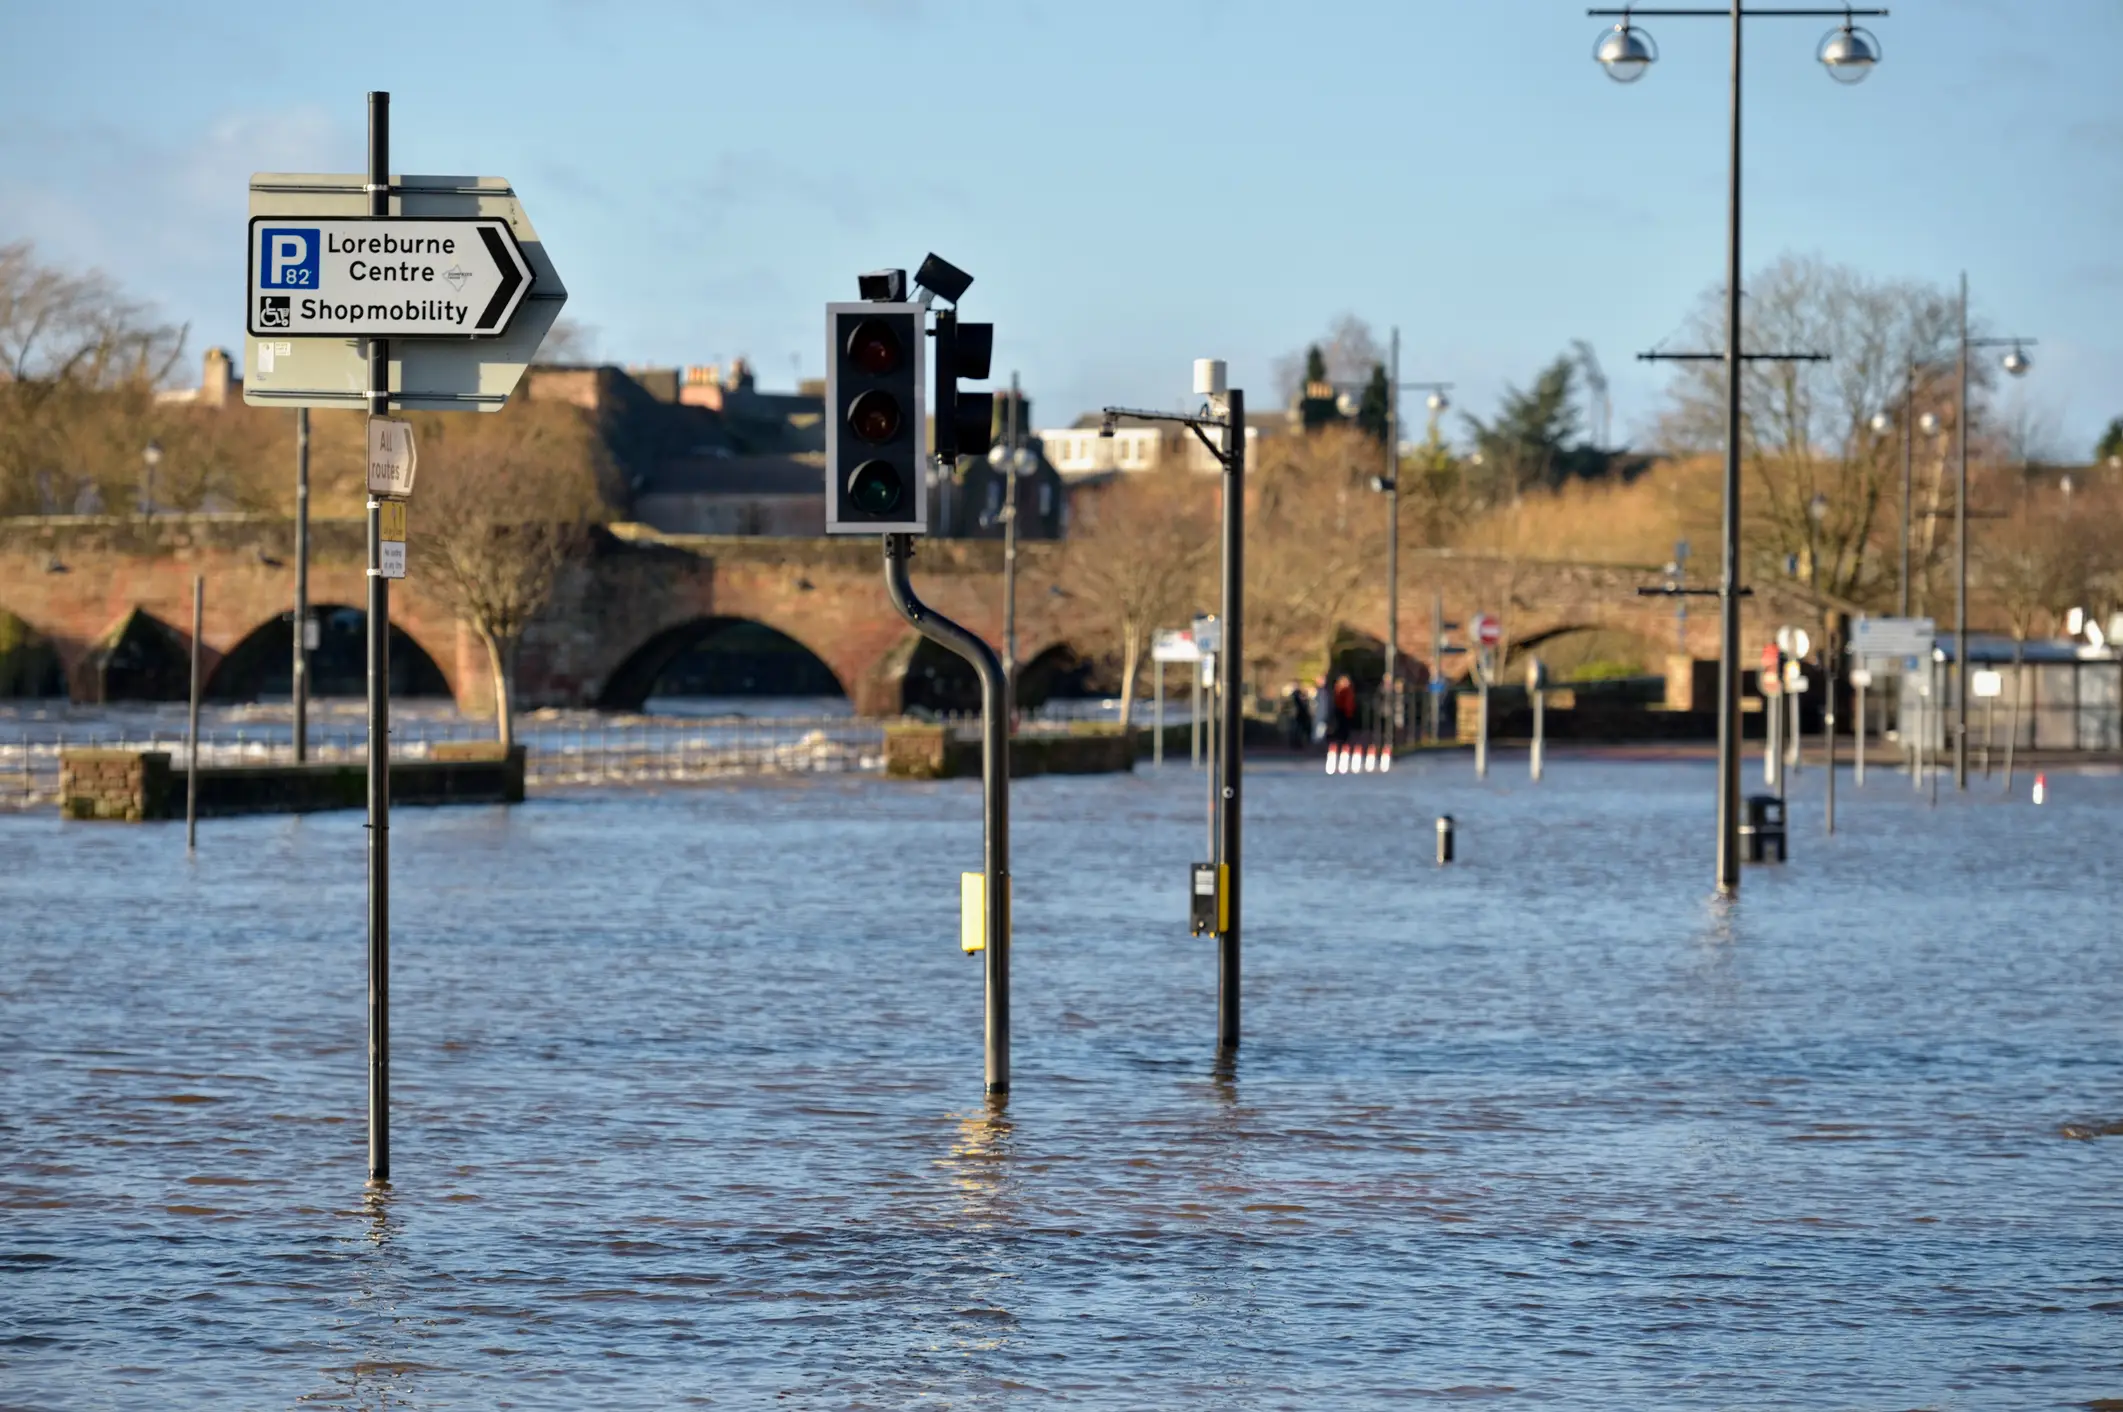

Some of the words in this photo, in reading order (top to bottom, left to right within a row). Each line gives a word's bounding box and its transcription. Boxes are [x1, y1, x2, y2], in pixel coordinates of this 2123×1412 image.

[329, 233, 454, 254] Loreburne
[271, 235, 307, 284] P
[285, 268, 310, 285] 82
[350, 261, 434, 281] Centre
[301, 299, 468, 324] Shopmobility
[380, 430, 392, 452] All
[371, 461, 400, 480] routes
